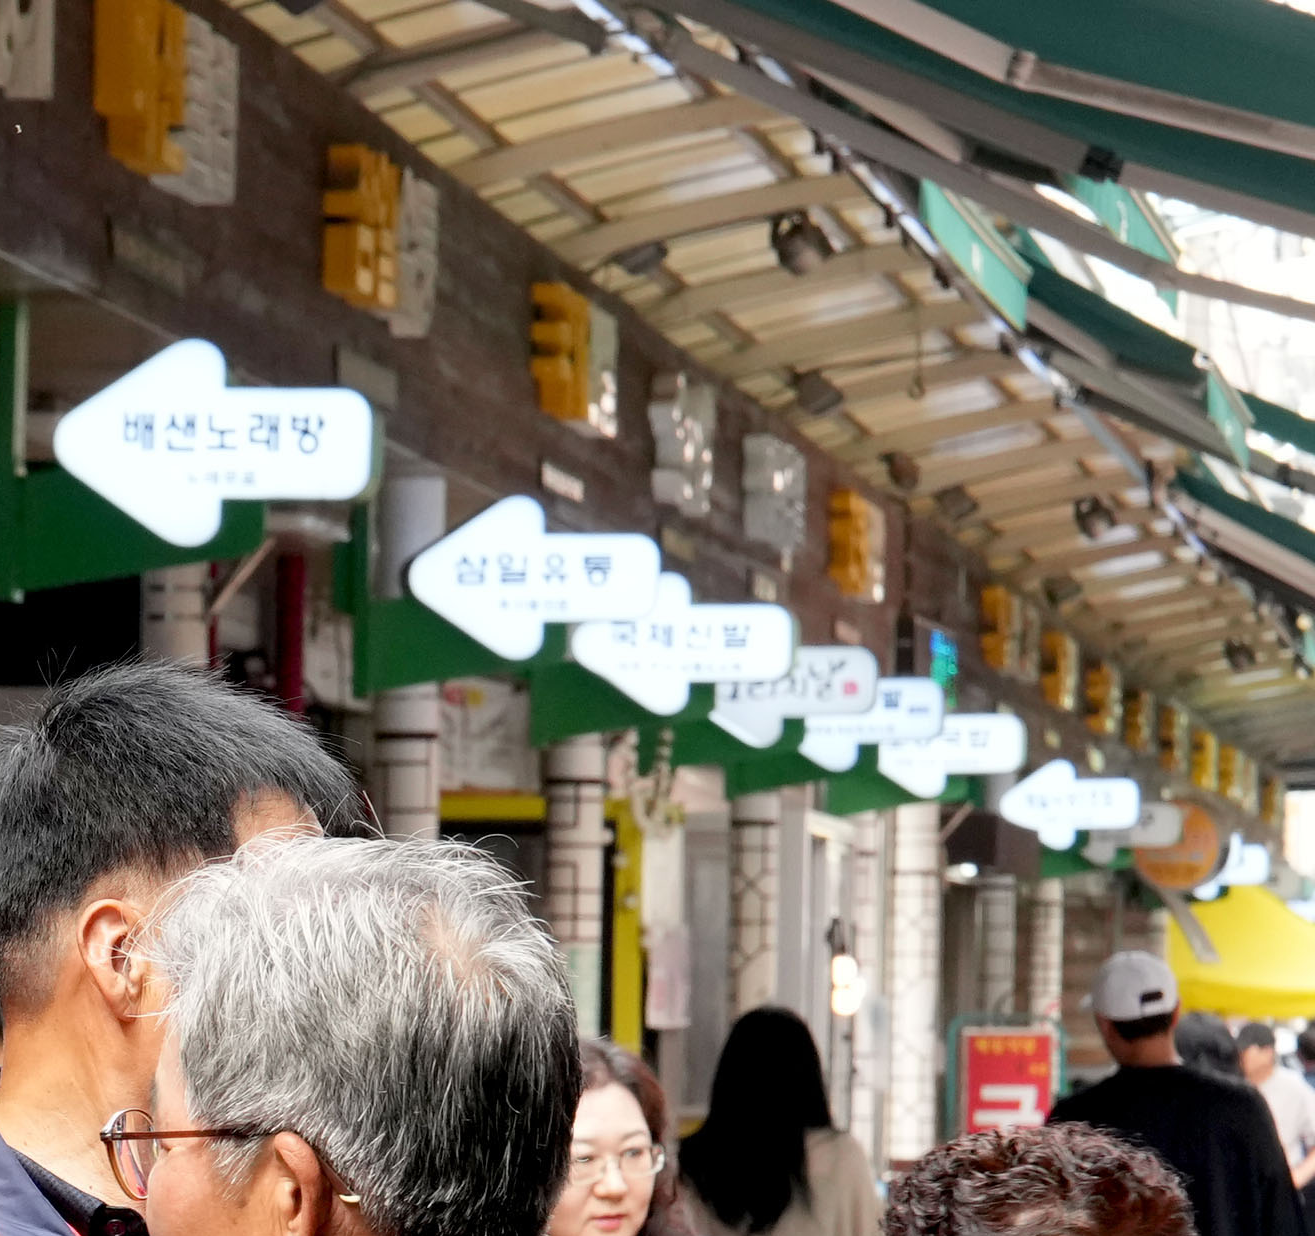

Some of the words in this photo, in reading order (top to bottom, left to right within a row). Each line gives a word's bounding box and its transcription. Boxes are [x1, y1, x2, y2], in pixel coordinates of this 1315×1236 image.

[123, 412, 327, 455] 배샌노래방
[454, 552, 614, 587] 삼일유통
[611, 620, 751, 649] 국제신발
